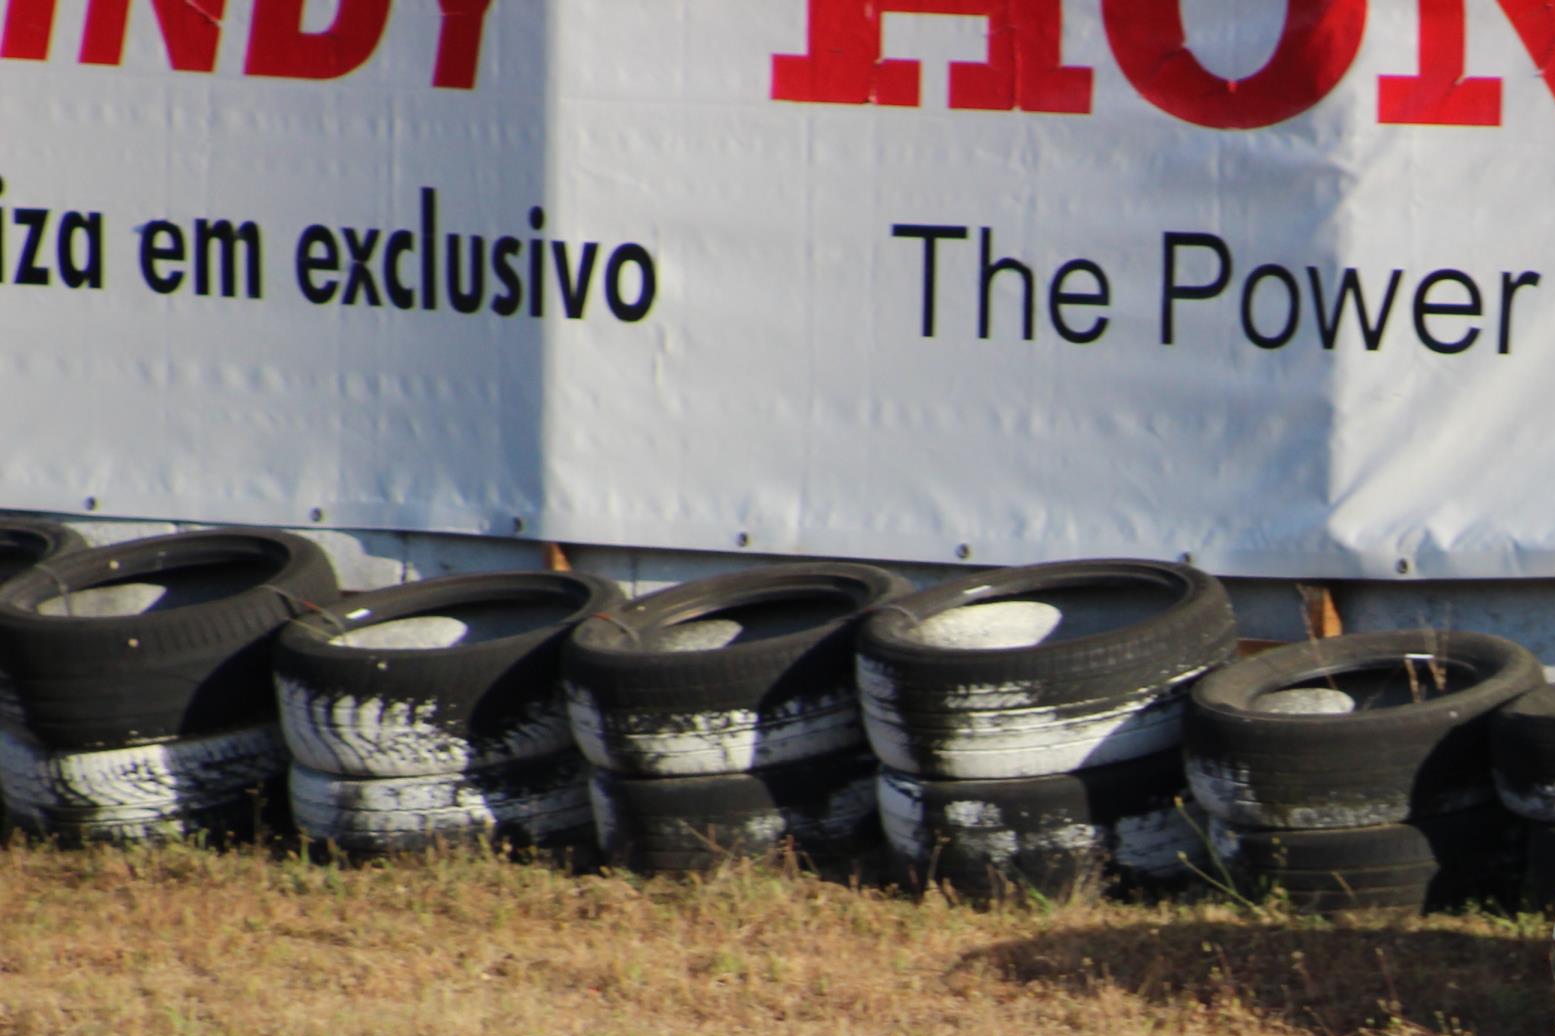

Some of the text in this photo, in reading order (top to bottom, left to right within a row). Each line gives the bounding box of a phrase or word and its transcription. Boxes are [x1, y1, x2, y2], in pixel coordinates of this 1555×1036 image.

[139, 217, 263, 299] em
[295, 186, 657, 322] exclusivo
[891, 223, 1110, 344] The
[1161, 231, 1541, 355] Power
